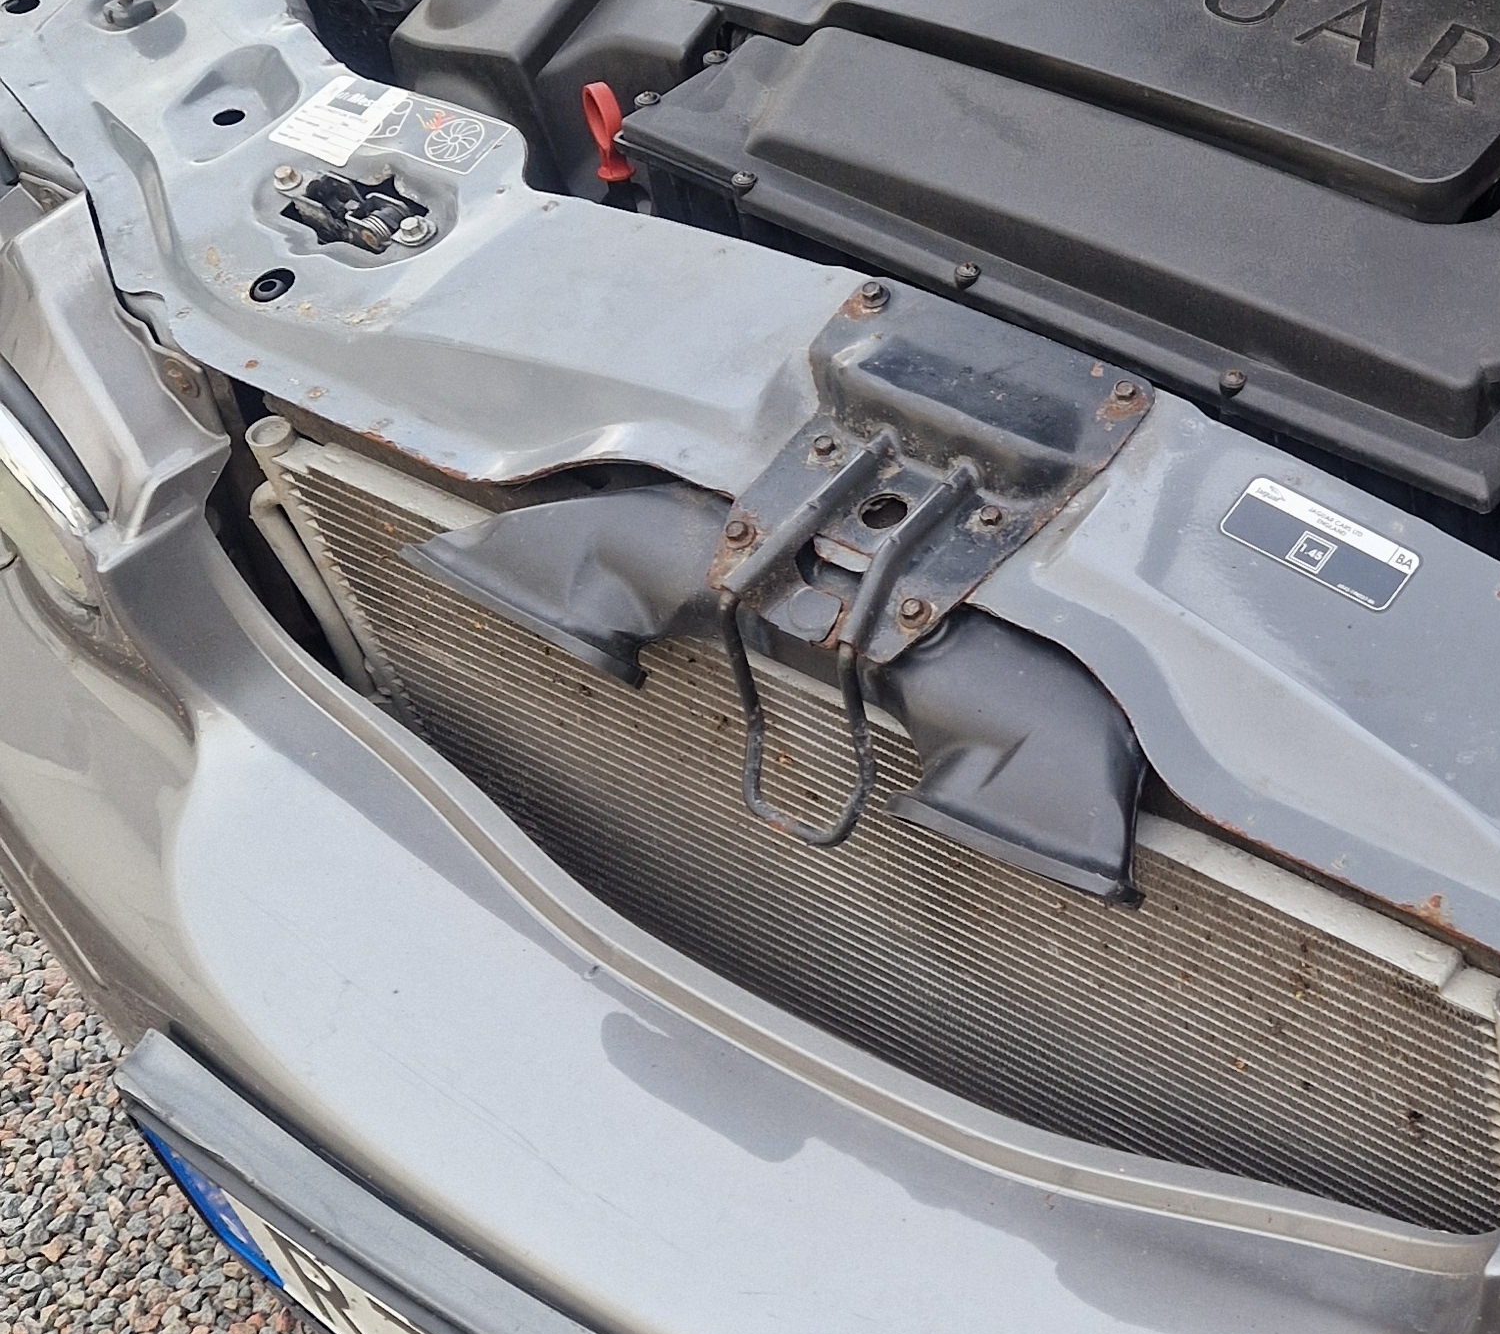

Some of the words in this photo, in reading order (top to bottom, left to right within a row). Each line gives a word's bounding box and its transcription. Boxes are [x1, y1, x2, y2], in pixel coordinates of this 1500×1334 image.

[1308, 507, 1335, 523] JAGUAR
[1316, 518, 1347, 537] ENGLAND
[1299, 543, 1325, 561] 1.45
[1395, 553, 1414, 570] BA
